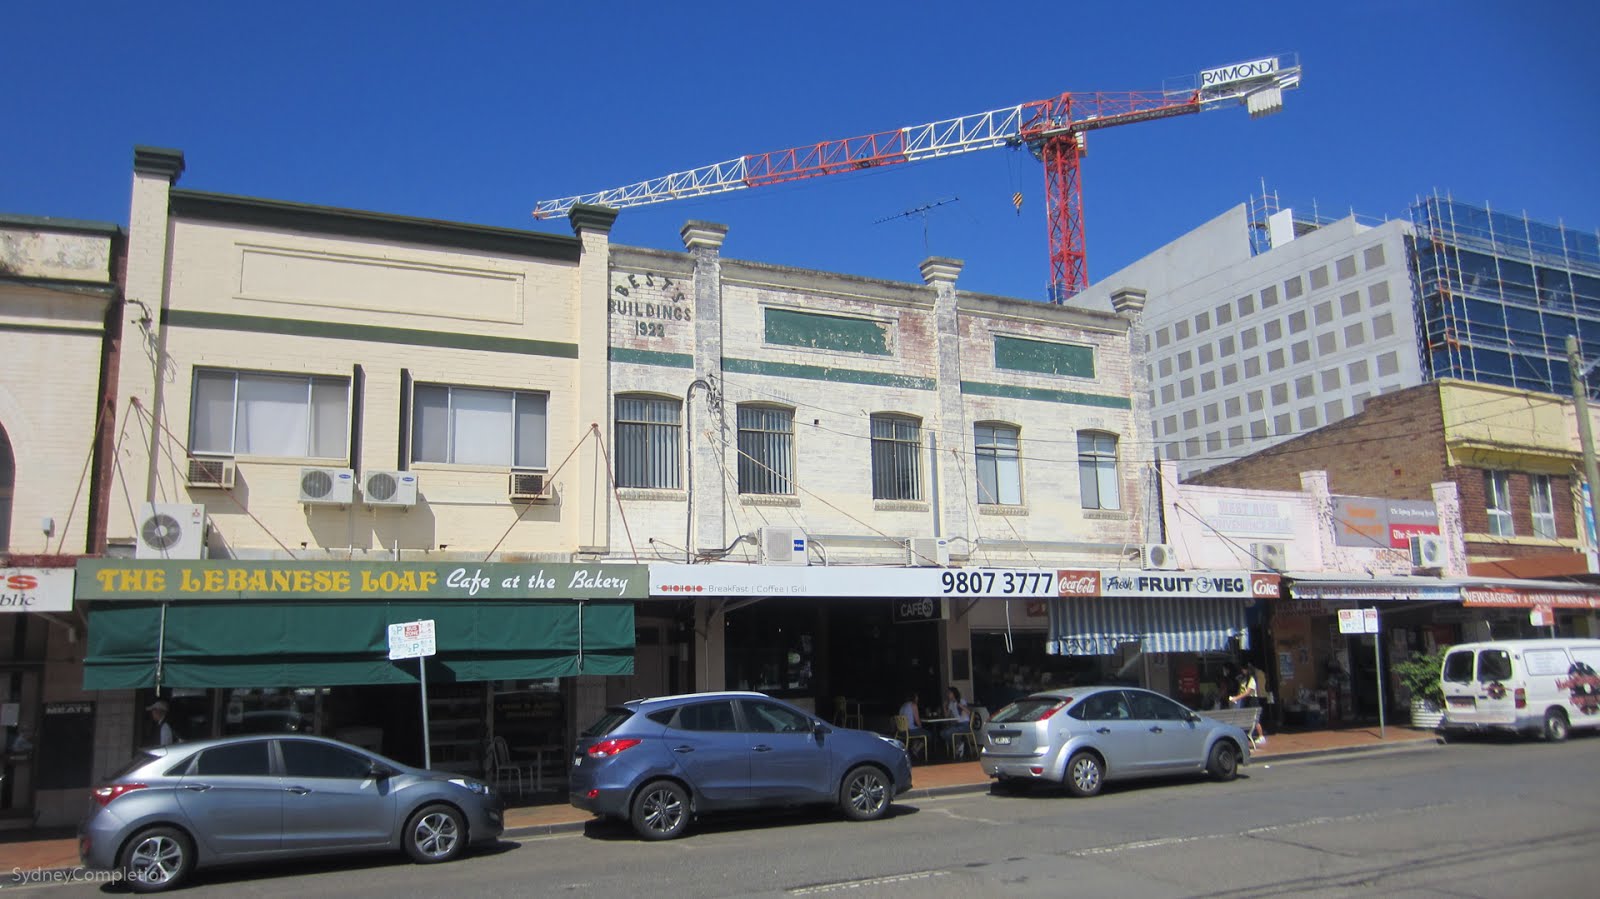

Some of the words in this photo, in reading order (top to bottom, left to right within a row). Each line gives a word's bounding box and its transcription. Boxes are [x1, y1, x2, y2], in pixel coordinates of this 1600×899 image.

[1201, 60, 1274, 85] RAIMONDI
[609, 300, 692, 322] BUILDINGS
[1392, 529, 1406, 540] The
[0, 574, 38, 590] S
[96, 569, 166, 592] THE
[180, 568, 351, 593] LEBANESE
[361, 569, 438, 593] LOAF
[446, 567, 491, 595] Cafe
[501, 574, 520, 589] at
[528, 570, 556, 590] the
[568, 568, 629, 596] Bakery
[708, 584, 748, 593] Breakfast
[756, 585, 784, 593] Coffee
[791, 585, 807, 593] Grill
[941, 571, 996, 595] 9807
[1002, 571, 1054, 595] 3777
[1106, 576, 1133, 592] Fresh
[1138, 576, 1193, 592] FRUIT
[1213, 577, 1244, 592] VEG
[1253, 579, 1278, 596] Coke
[1465, 590, 1521, 603] NEWSAGENCY
